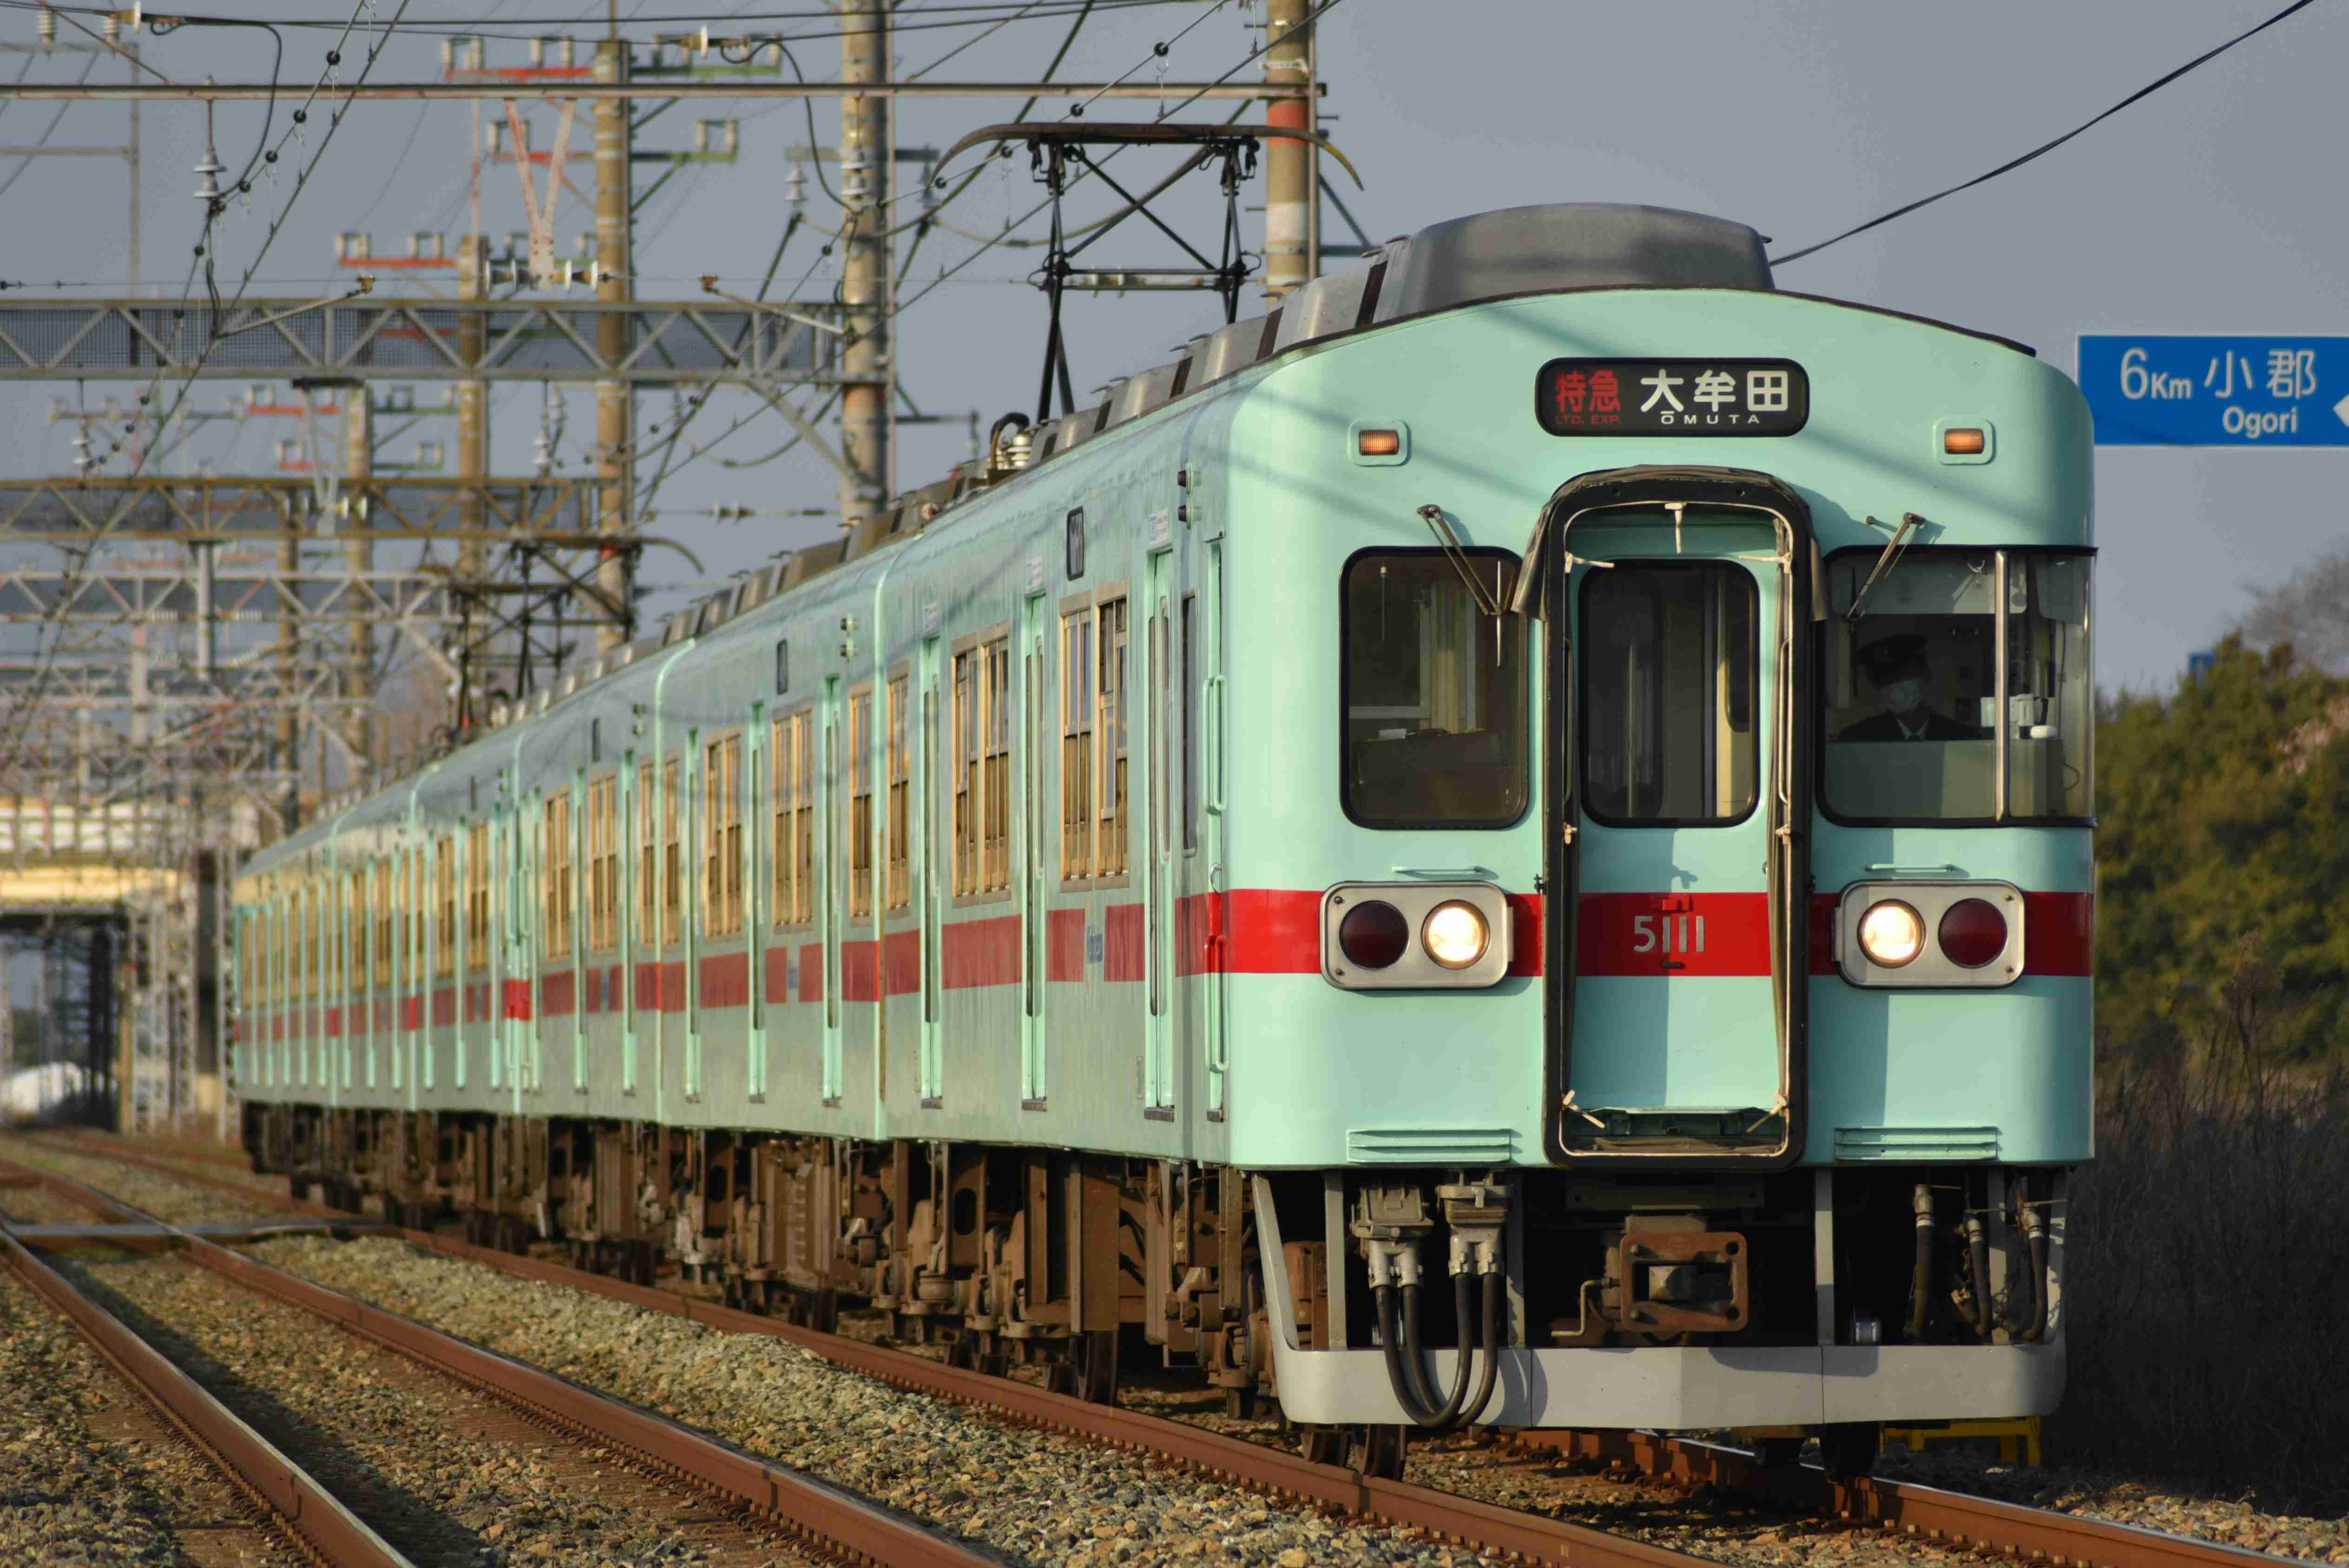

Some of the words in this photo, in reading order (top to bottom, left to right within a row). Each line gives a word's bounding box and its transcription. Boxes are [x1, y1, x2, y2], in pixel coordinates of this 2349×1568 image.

[1555, 370, 1622, 412] 特急
[1640, 369, 1788, 412] 大牟田
[2204, 350, 2317, 400] 小郡
[2222, 406, 2298, 439] Ogori
[1633, 915, 1706, 953] 5111
